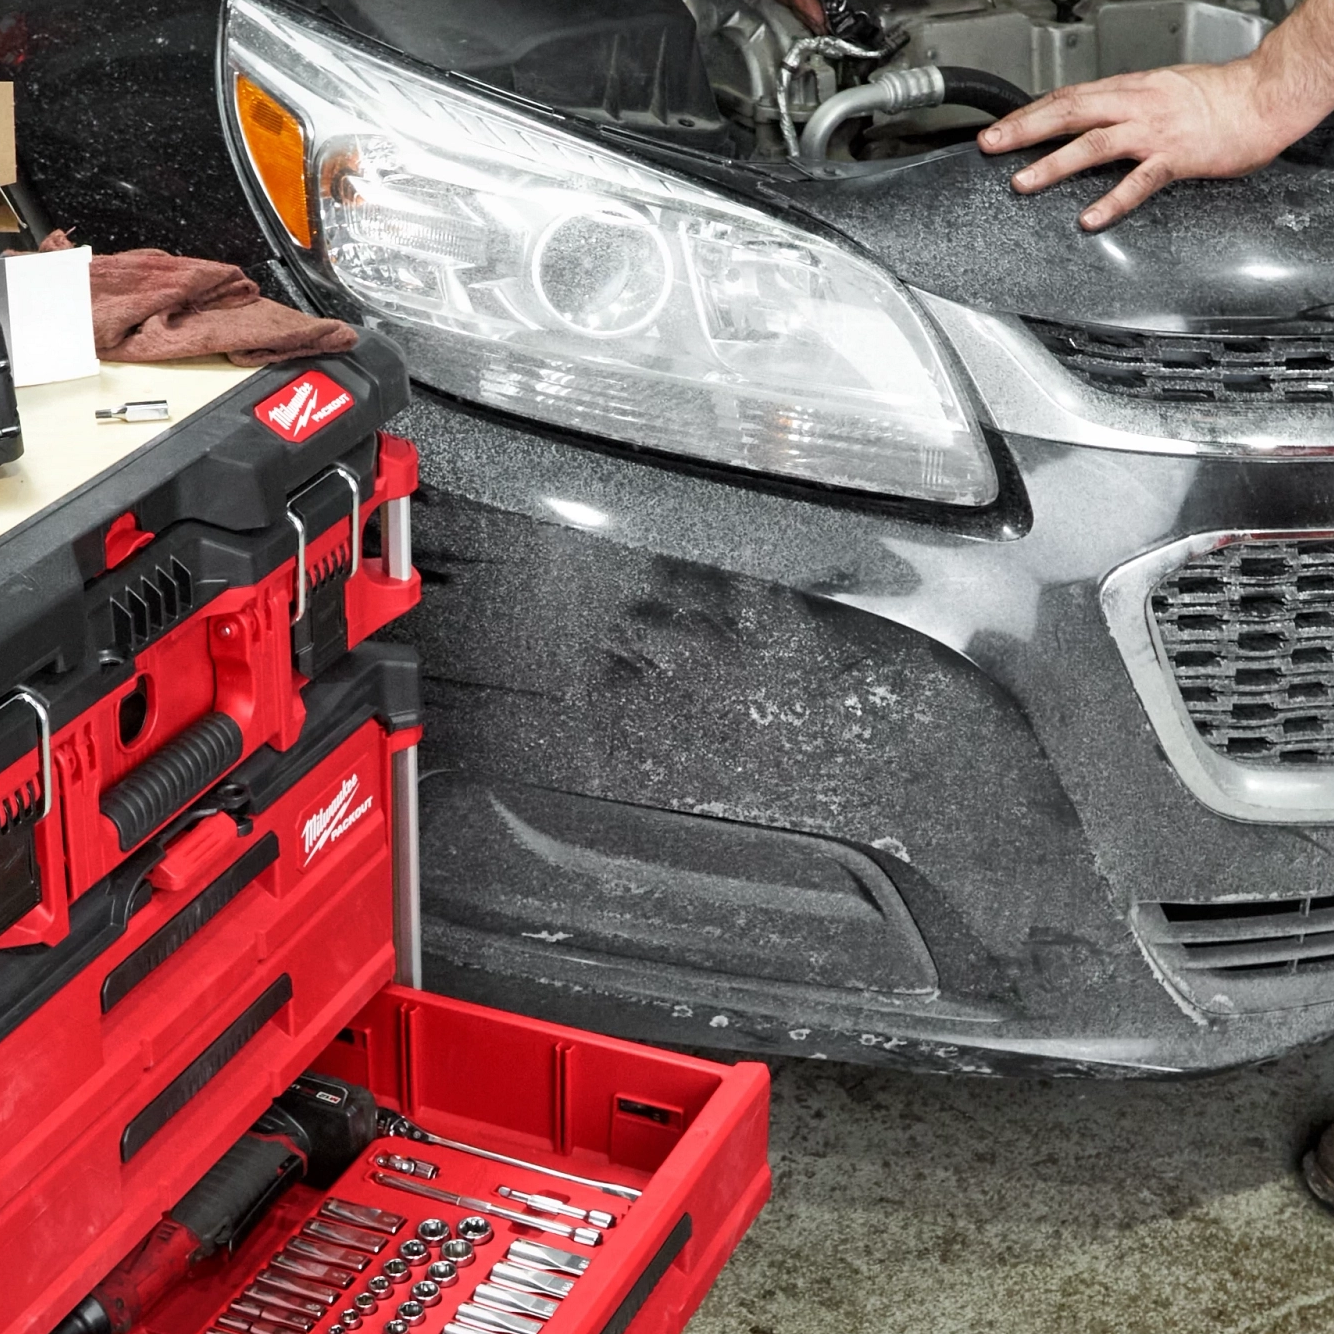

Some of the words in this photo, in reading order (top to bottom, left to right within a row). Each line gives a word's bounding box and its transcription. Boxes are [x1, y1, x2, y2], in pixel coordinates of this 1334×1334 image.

[268, 382, 313, 430] Milwaukee
[311, 393, 350, 422] PACKOUT
[301, 773, 358, 853] Milwaukee
[330, 795, 373, 842] PACKOUT
